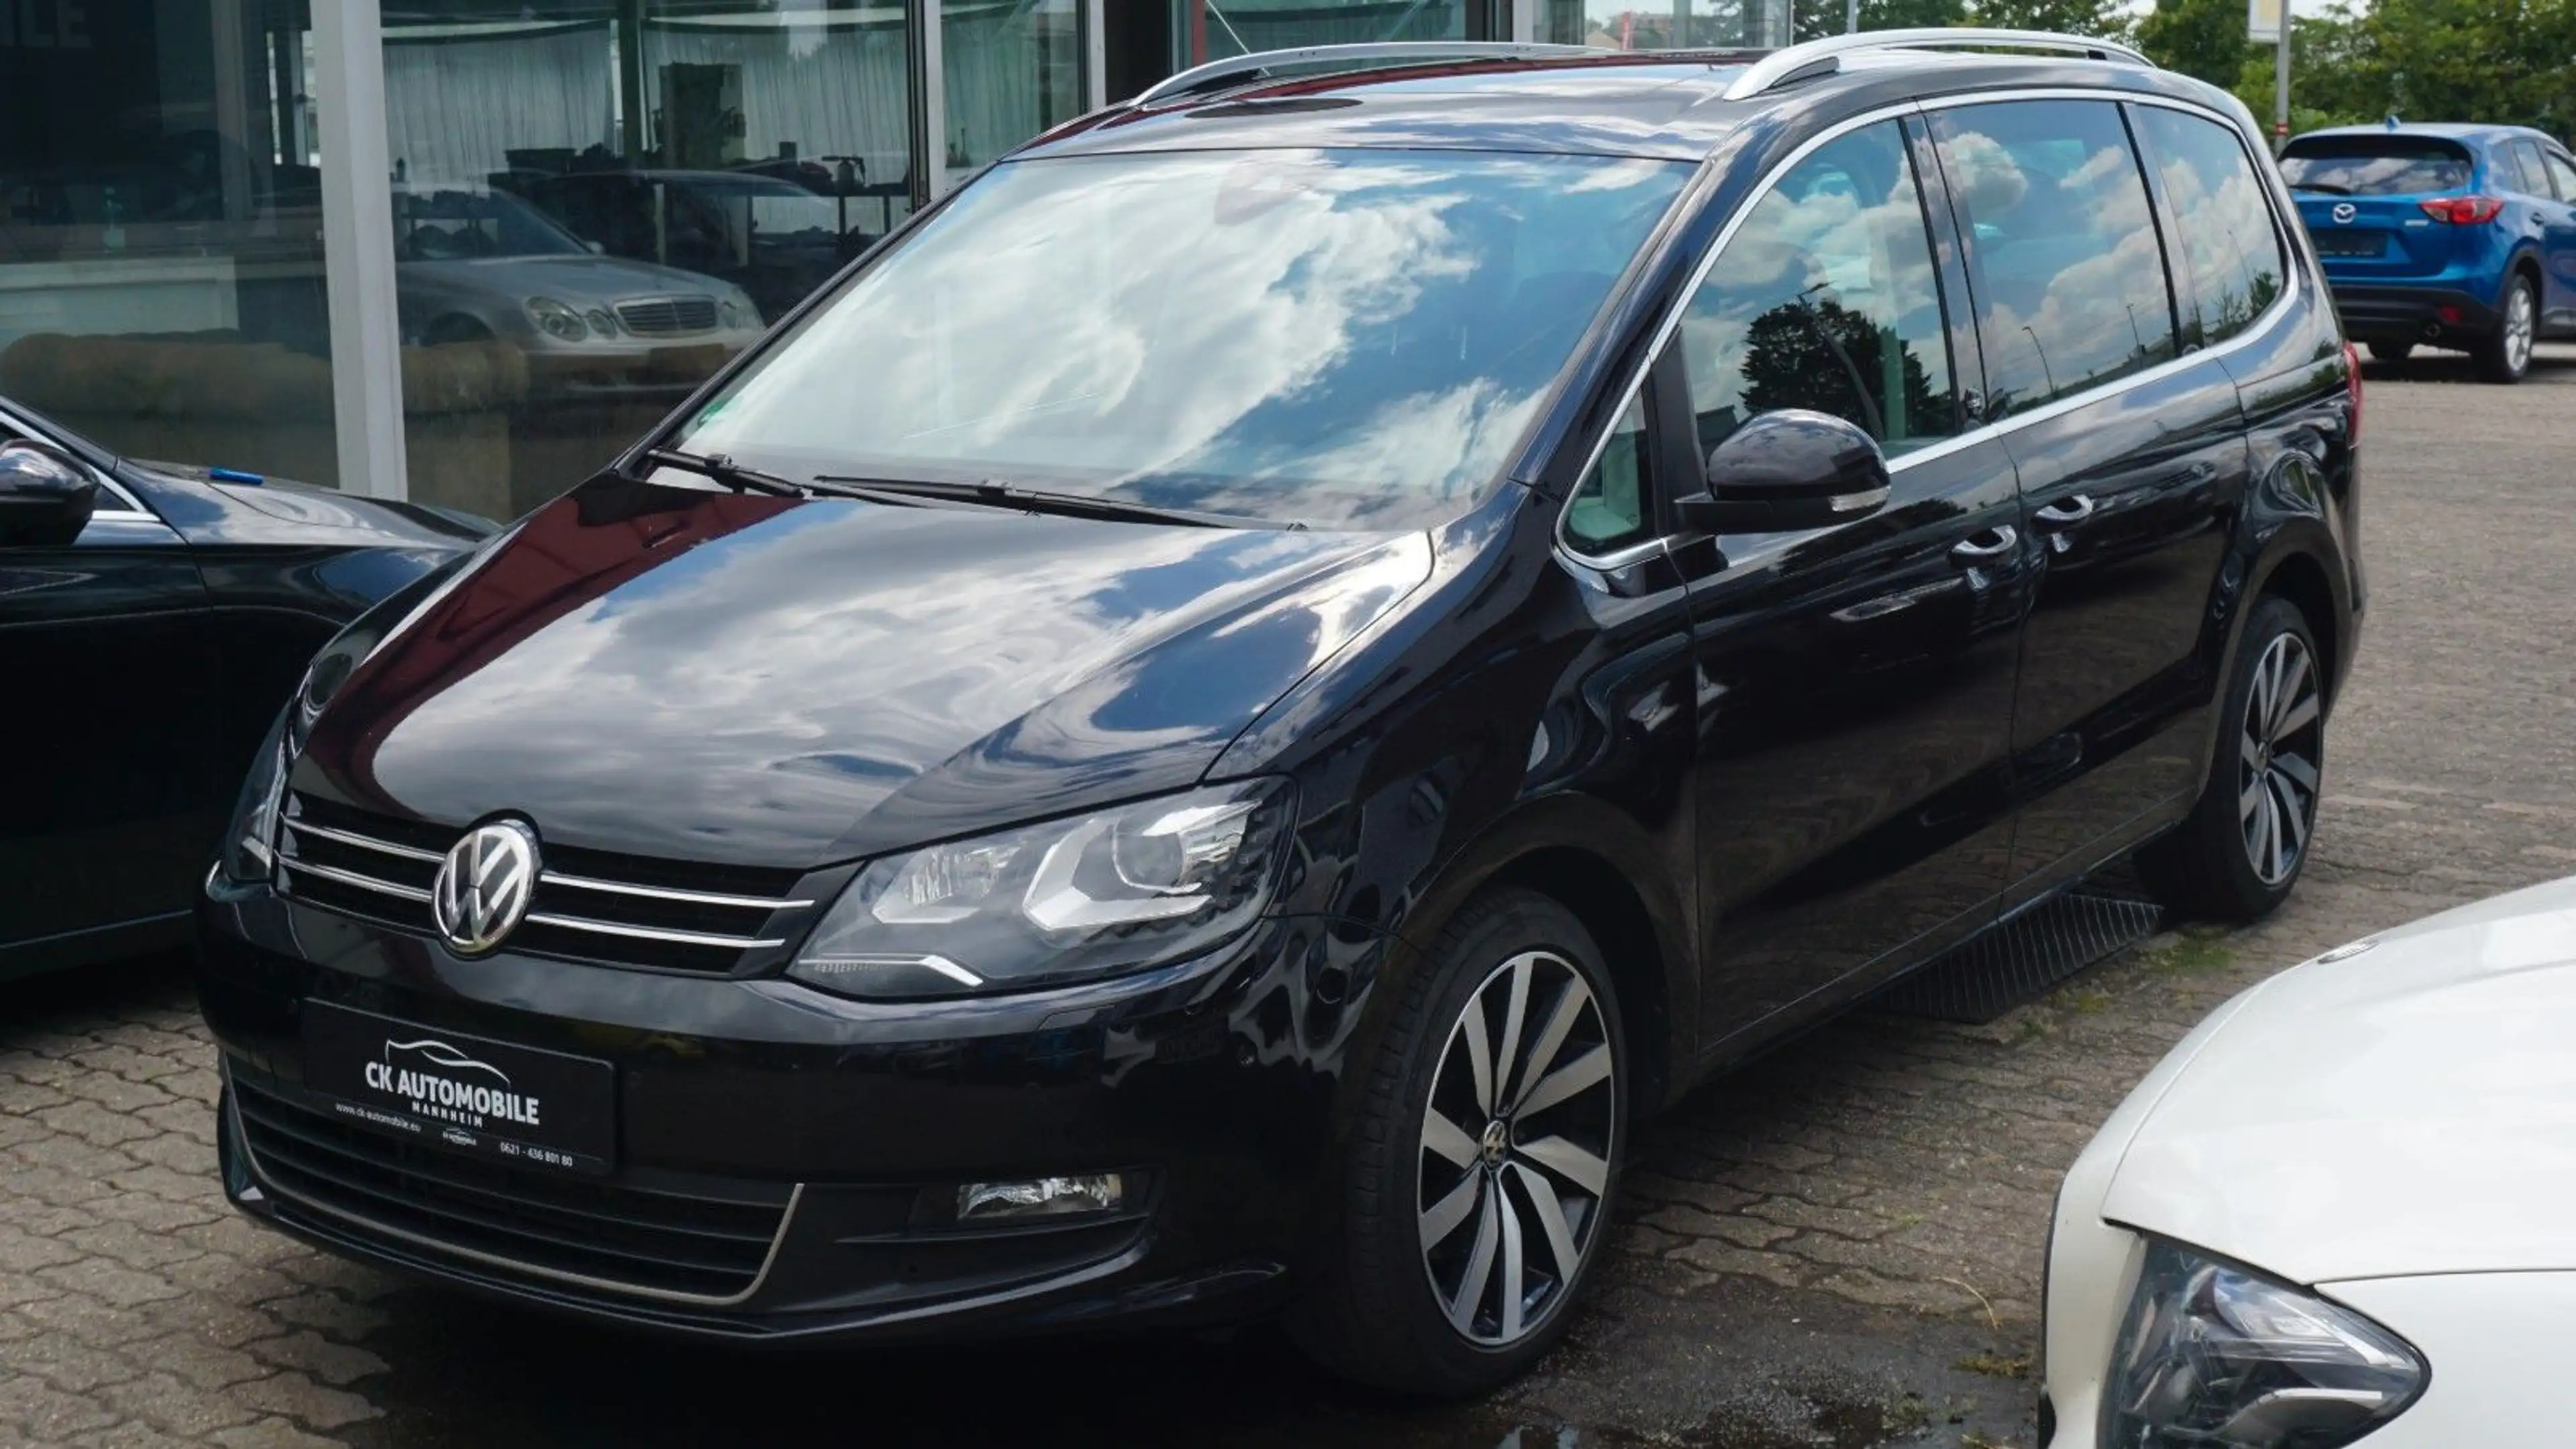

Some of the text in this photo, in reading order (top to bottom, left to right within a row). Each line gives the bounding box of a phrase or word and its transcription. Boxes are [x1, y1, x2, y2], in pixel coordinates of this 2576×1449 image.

[365, 1061, 540, 1125] CK AUTOMOBILE
[413, 1101, 483, 1128] MANNHEIM
[500, 1141, 520, 1156] 0621
[527, 1147, 543, 1161] 436
[561, 1155, 573, 1167] 80
